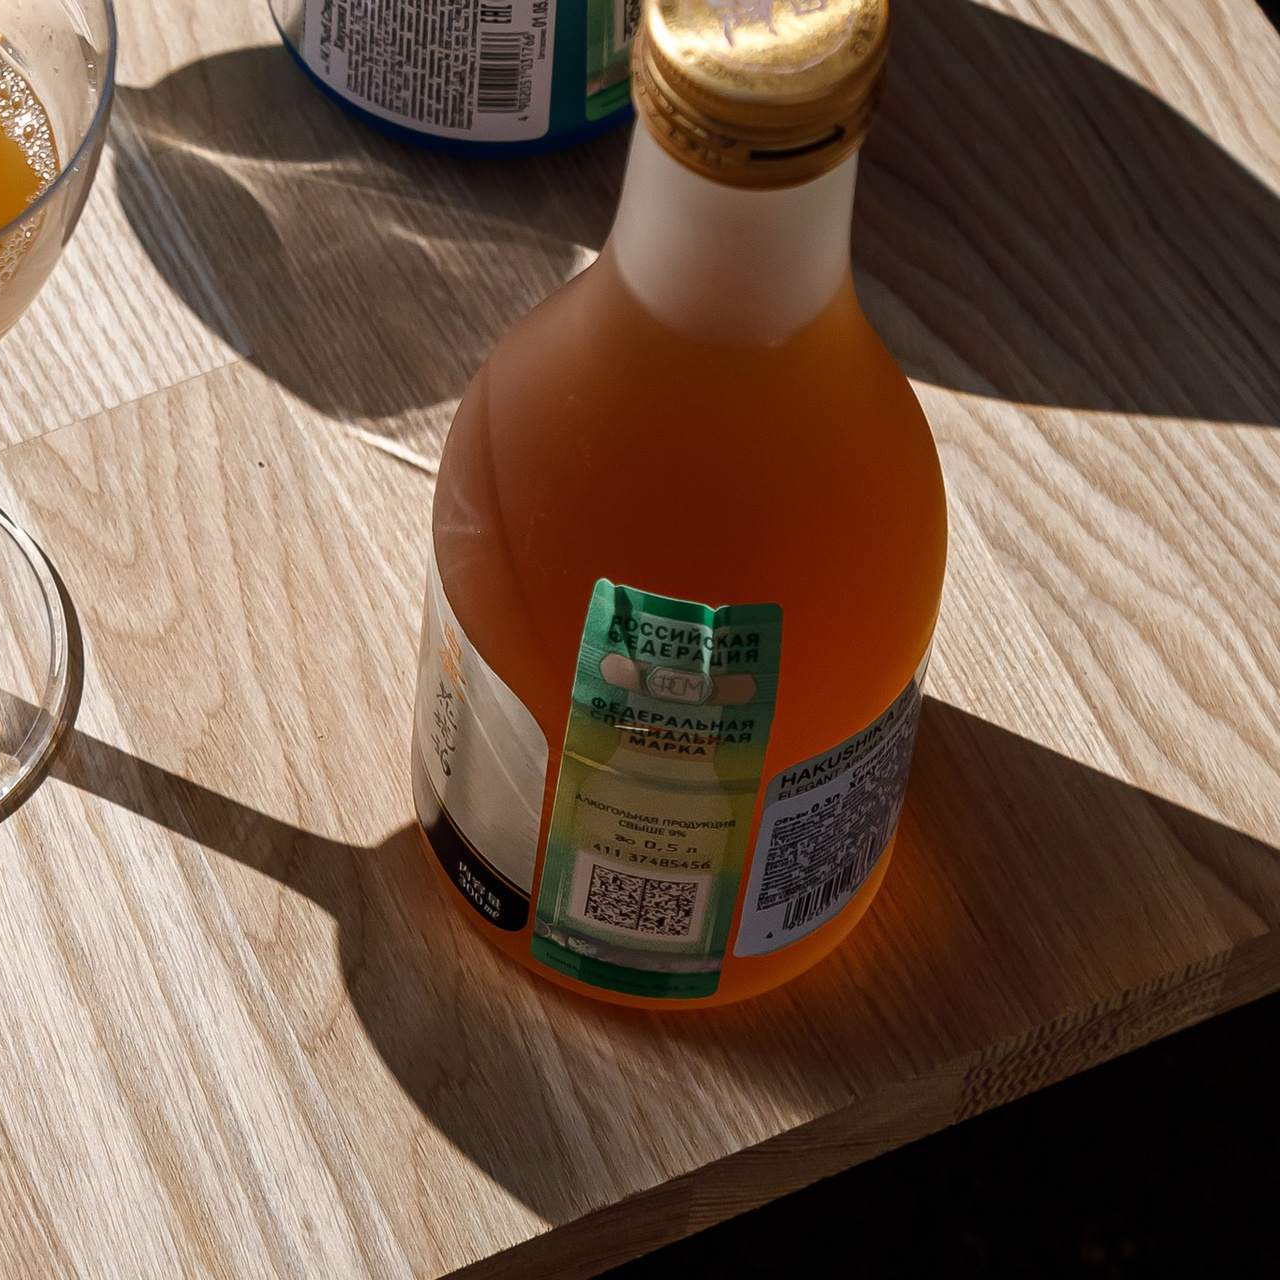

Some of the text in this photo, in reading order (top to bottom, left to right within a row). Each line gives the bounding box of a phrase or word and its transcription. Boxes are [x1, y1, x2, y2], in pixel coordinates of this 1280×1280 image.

[608, 631, 759, 668] ФЕДЕРАЦИЯ
[611, 615, 760, 651] РОССИЙСКАЯ
[591, 696, 755, 733] ФЕДЕРАЛЬНАЯ
[629, 736, 708, 756] МАРКА
[780, 711, 894, 790] HAKUSHIKA
[575, 793, 737, 831] АЛКОГОЛЬНАЯ ПРОДУКЦИЯ
[618, 819, 665, 837] СВЫШЕ
